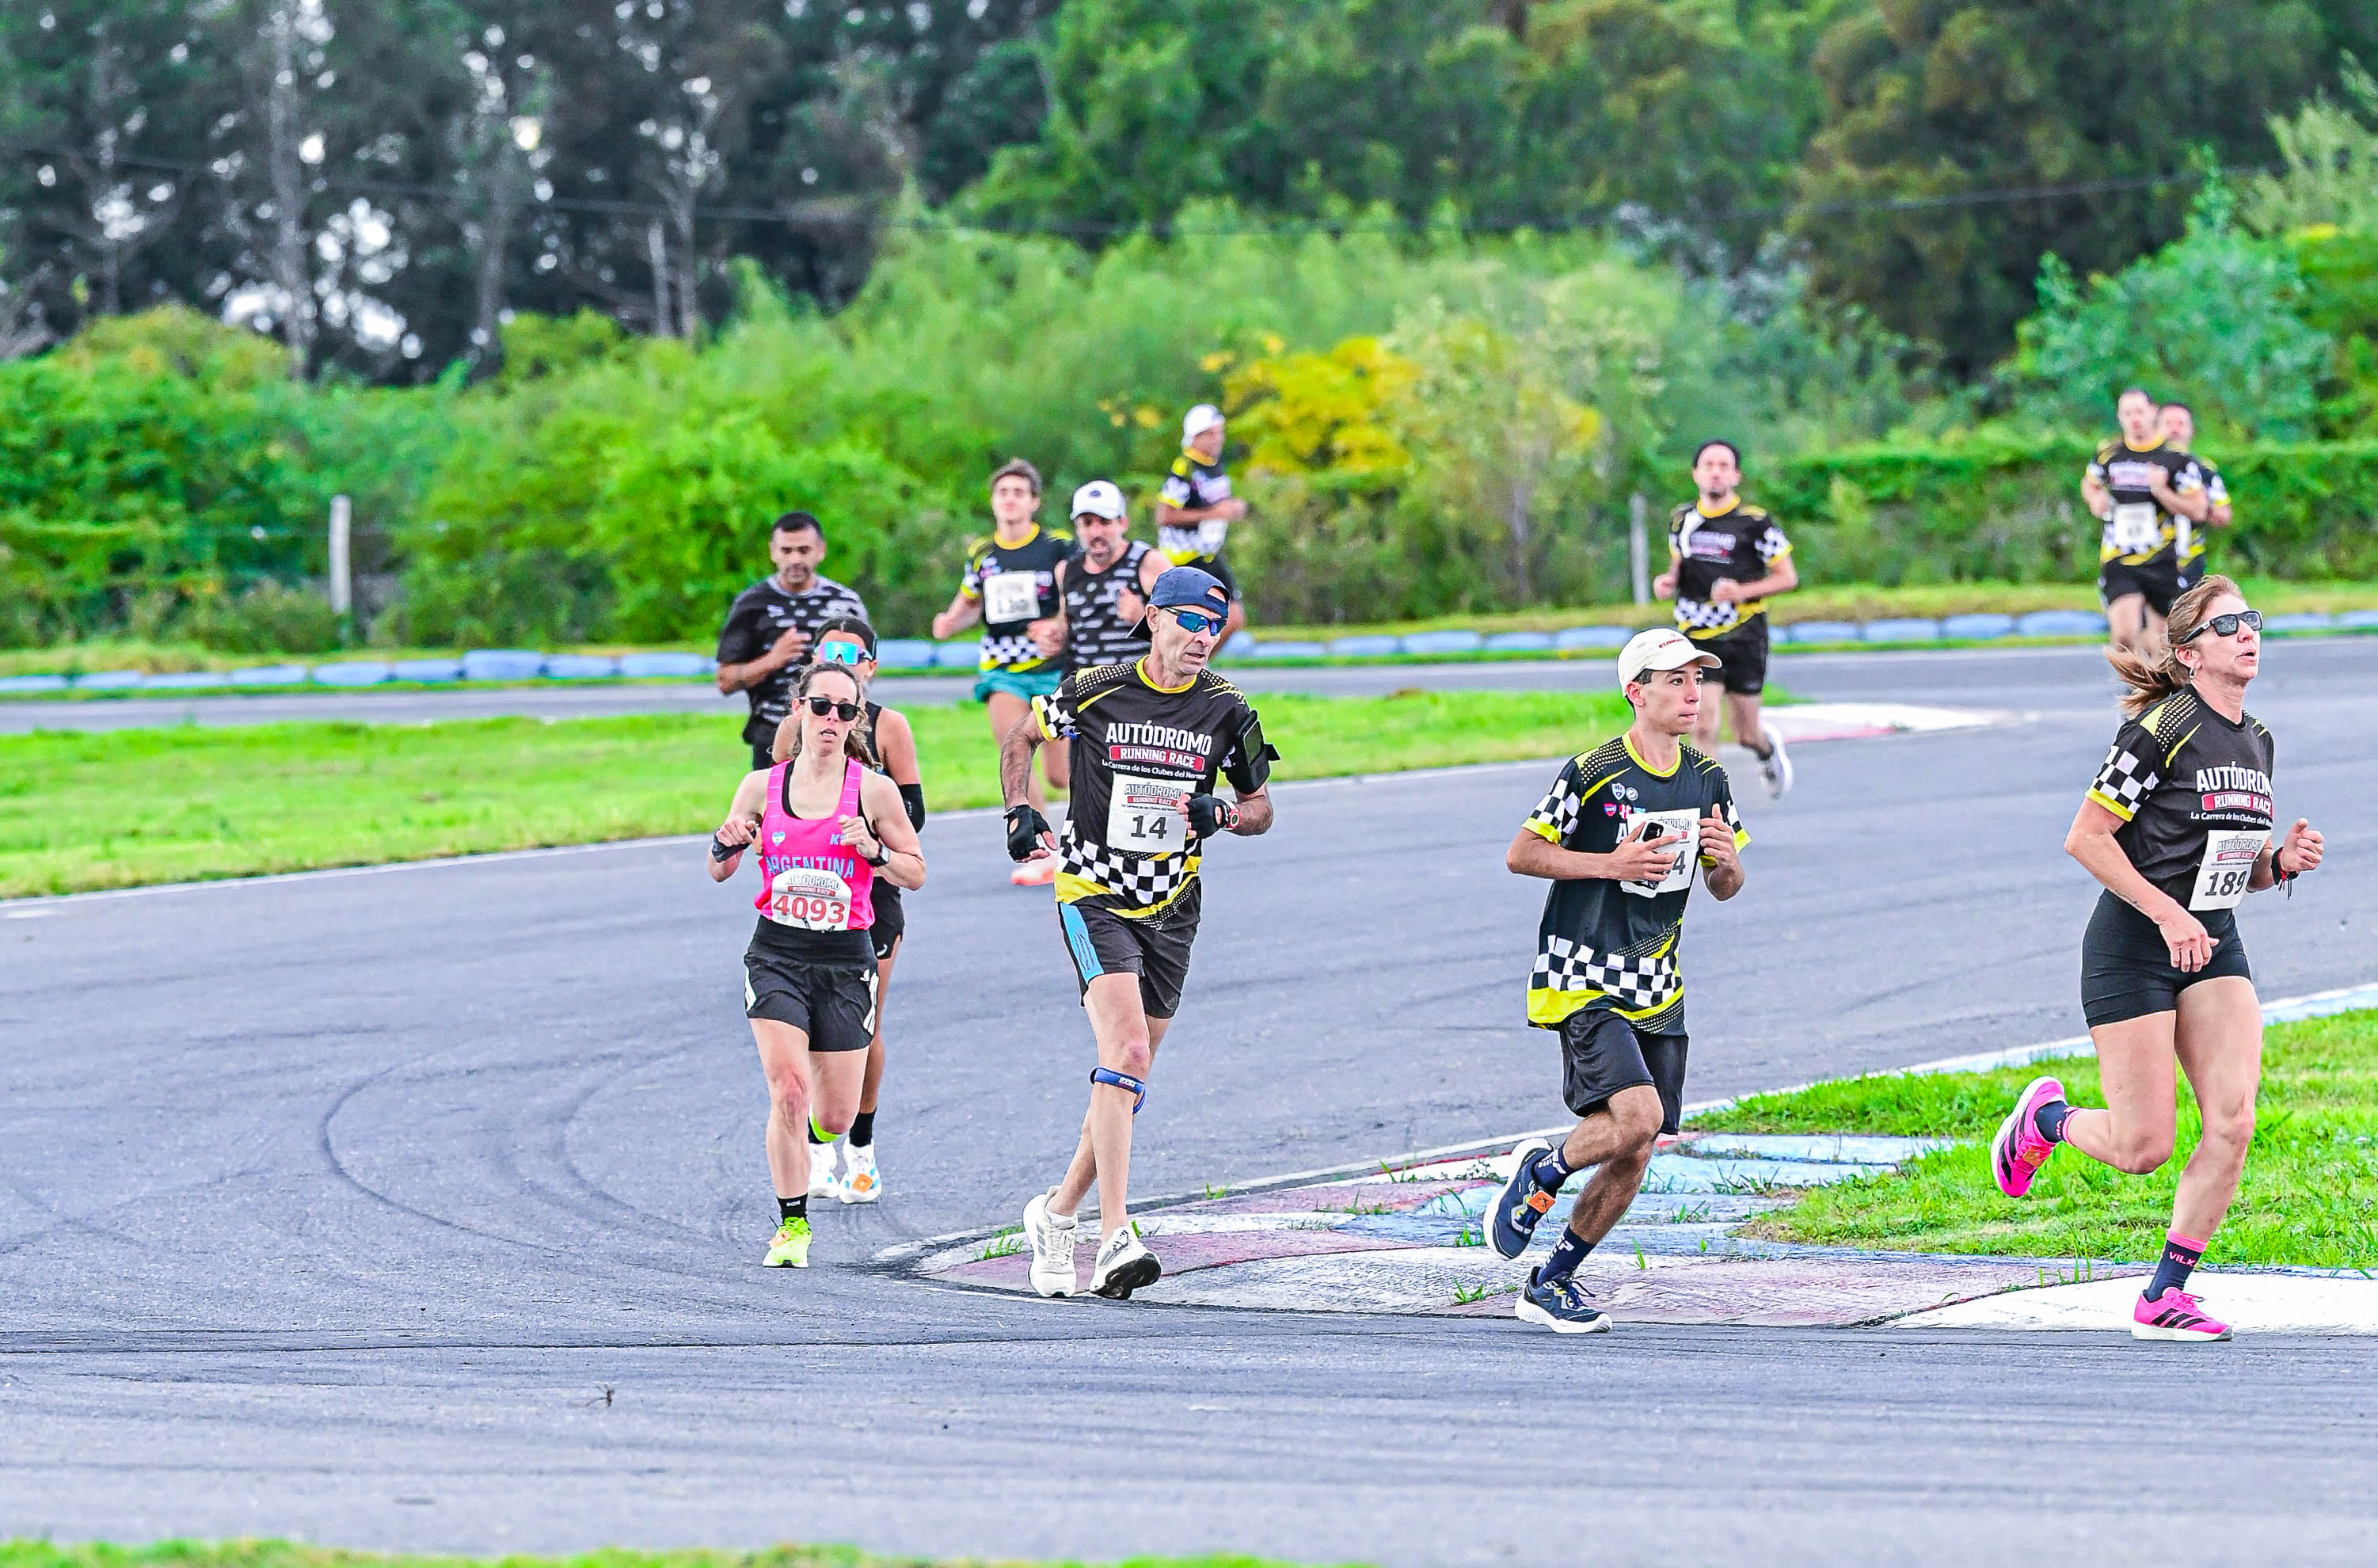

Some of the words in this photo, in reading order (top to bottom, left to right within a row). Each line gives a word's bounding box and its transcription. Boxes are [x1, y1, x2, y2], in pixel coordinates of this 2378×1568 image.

[1105, 720, 1212, 755] AUTÓDROMO
[1109, 761, 1131, 771] Carrera
[1141, 765, 1151, 774] los
[1151, 767, 1174, 777] Clubes
[1120, 748, 1166, 763] RUNNING
[1169, 752, 1197, 768] RACE
[1124, 782, 1183, 799] AUTÓDROMO
[2214, 794, 2251, 808] RUNNING
[2253, 796, 2272, 815] RACE
[1131, 815, 1167, 839] 14
[765, 855, 854, 879] ARGENTINA
[773, 895, 845, 923] 4093
